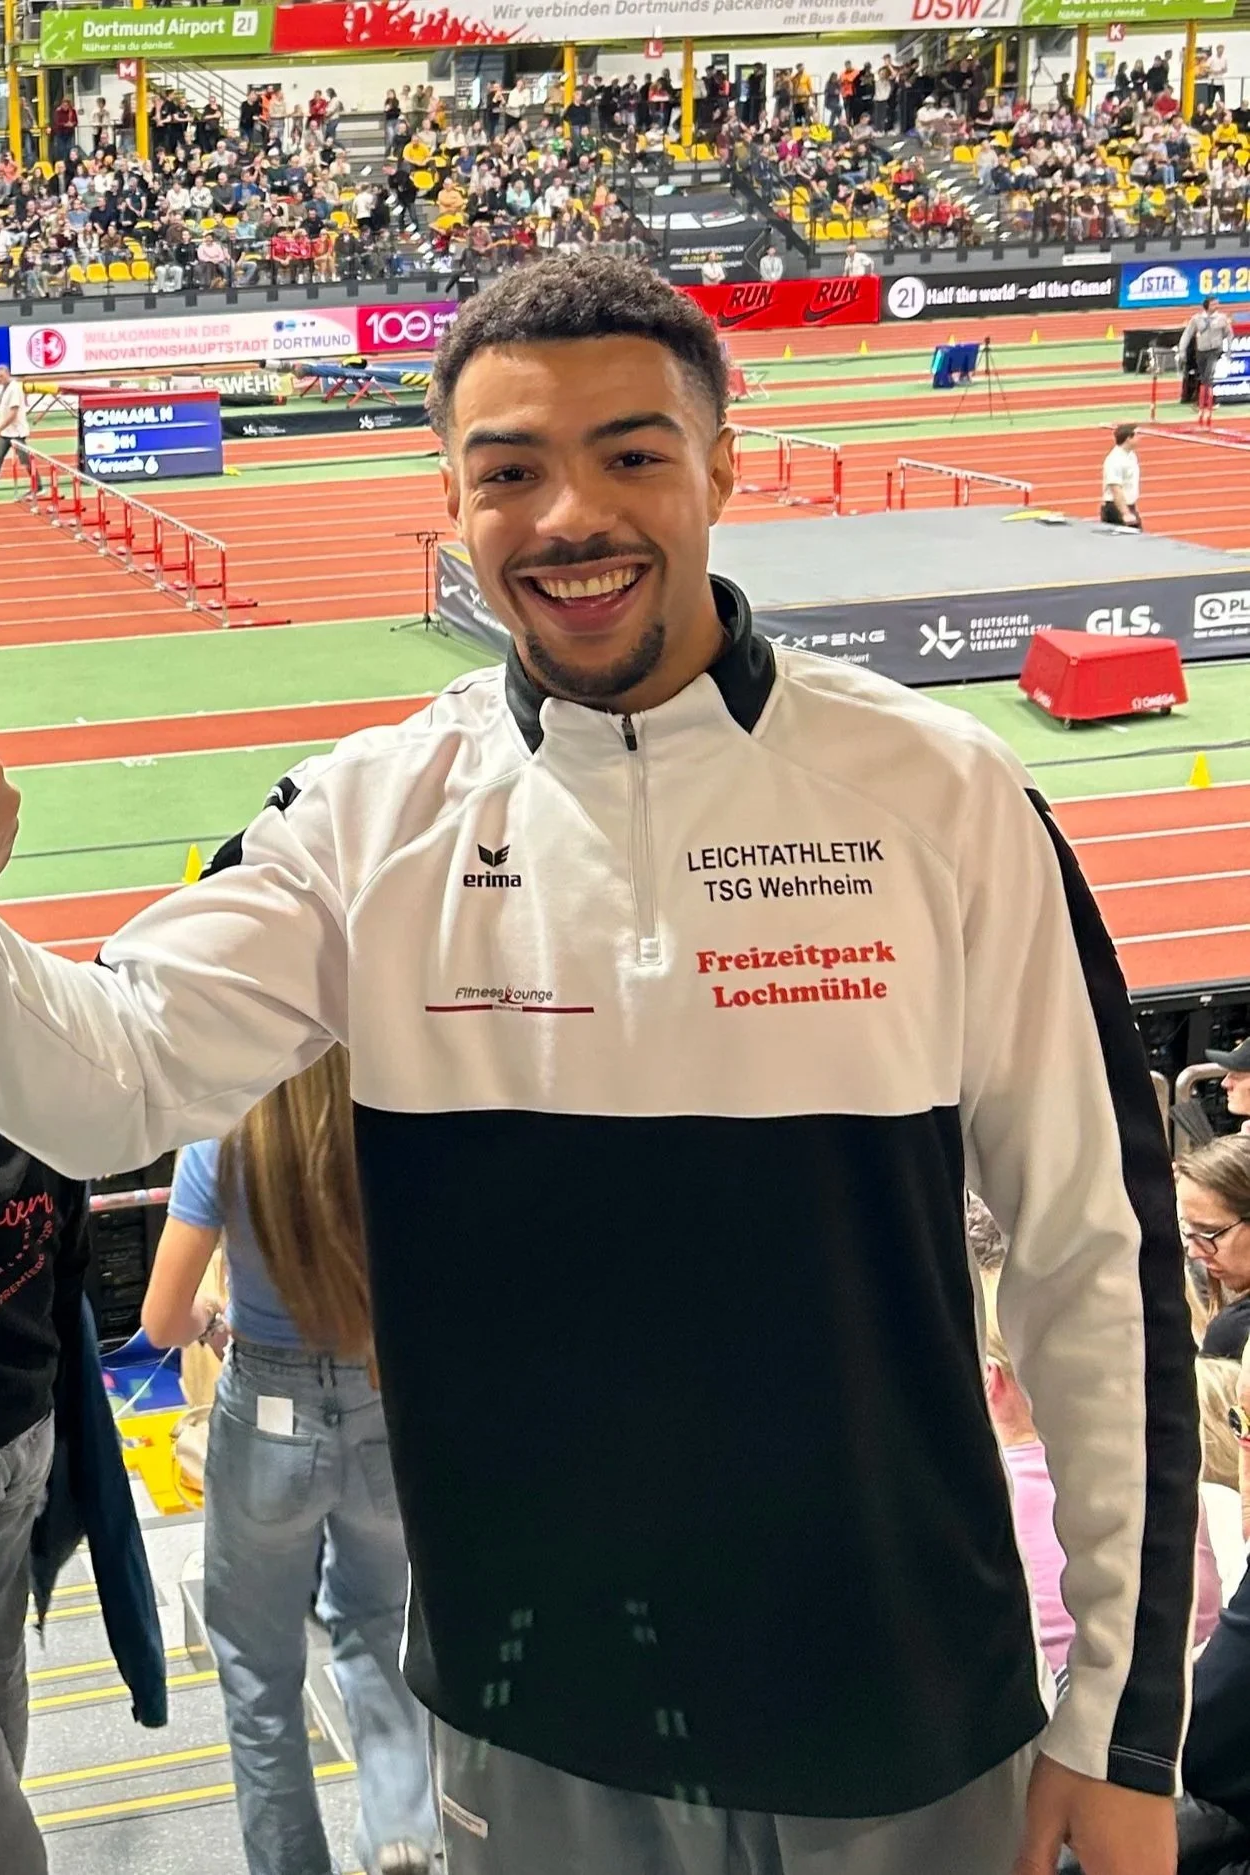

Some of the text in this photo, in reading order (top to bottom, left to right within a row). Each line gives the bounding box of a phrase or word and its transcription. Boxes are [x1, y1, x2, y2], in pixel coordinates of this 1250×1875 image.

[493, 5, 520, 20] Wir
[526, 2, 610, 18] verbinden
[615, 0, 709, 15] Dortmunds
[783, 11, 884, 25] mit Bus & Bahn
[83, 18, 226, 38] Dortmund Airport
[1110, 25, 1122, 38] K
[649, 41, 659, 56] L
[119, 62, 137, 78] M
[1199, 267, 1250, 294] 6.3.2
[730, 285, 775, 308] RUN
[816, 280, 861, 303] RUN
[927, 288, 954, 304] Half
[956, 286, 978, 303] the
[980, 283, 1016, 302] world
[1029, 282, 1046, 299] all
[1048, 281, 1069, 298] the
[1071, 278, 1112, 297] Game!
[84, 324, 231, 343] WILLKOMMEN IN DER
[366, 310, 431, 345] 100
[84, 338, 269, 361] INNOVATIONSHAUPTSTADT
[273, 334, 350, 349] DORTMUND
[970, 614, 1029, 629] DEUTSCHER
[1086, 604, 1161, 636] GLS.
[792, 629, 886, 649] XPENG
[970, 638, 1018, 652] VERBAND
[687, 840, 885, 872] LEICHTATHLETIK
[463, 872, 522, 888] erima
[704, 875, 873, 903] TSG Wehrheim
[696, 940, 896, 975] Freizeitpark
[711, 977, 888, 1009] Lochmühle
